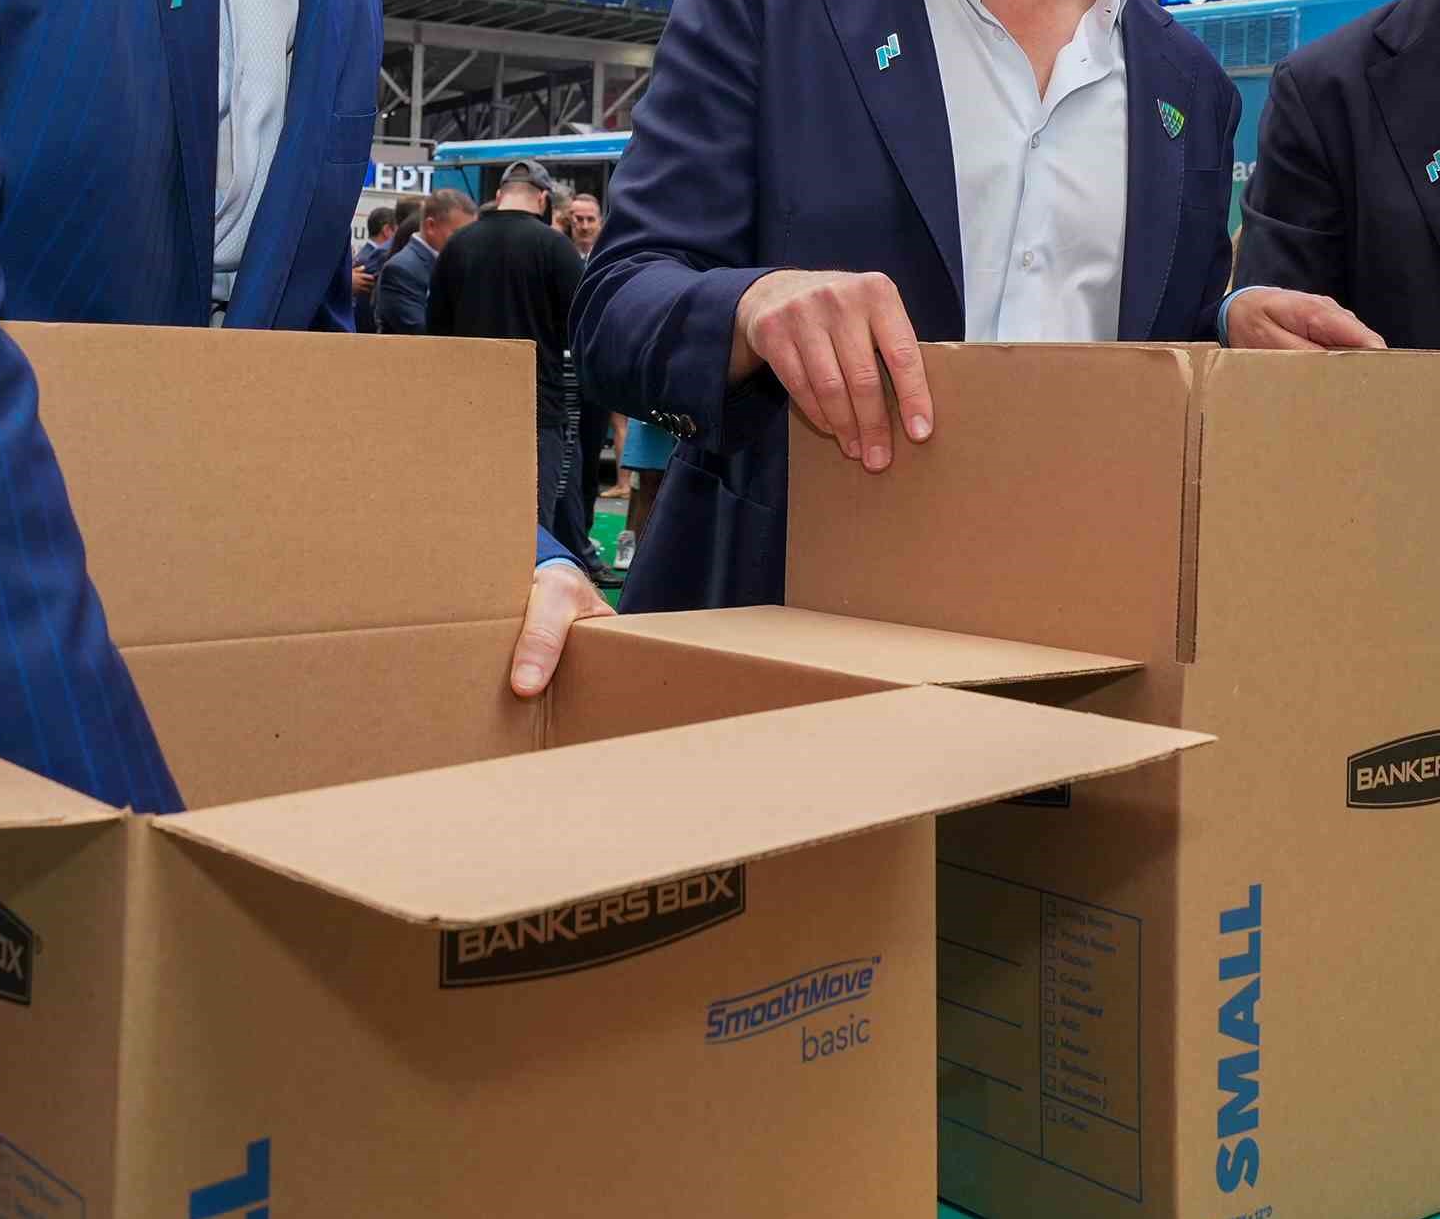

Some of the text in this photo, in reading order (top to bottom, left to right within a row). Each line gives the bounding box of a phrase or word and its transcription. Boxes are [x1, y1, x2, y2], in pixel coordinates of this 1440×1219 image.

[459, 871, 735, 964] BANKERS BOX
[706, 965, 874, 1040] SmoothMove
[801, 1014, 870, 1064] basic
[1216, 882, 1262, 1194] SMALL
